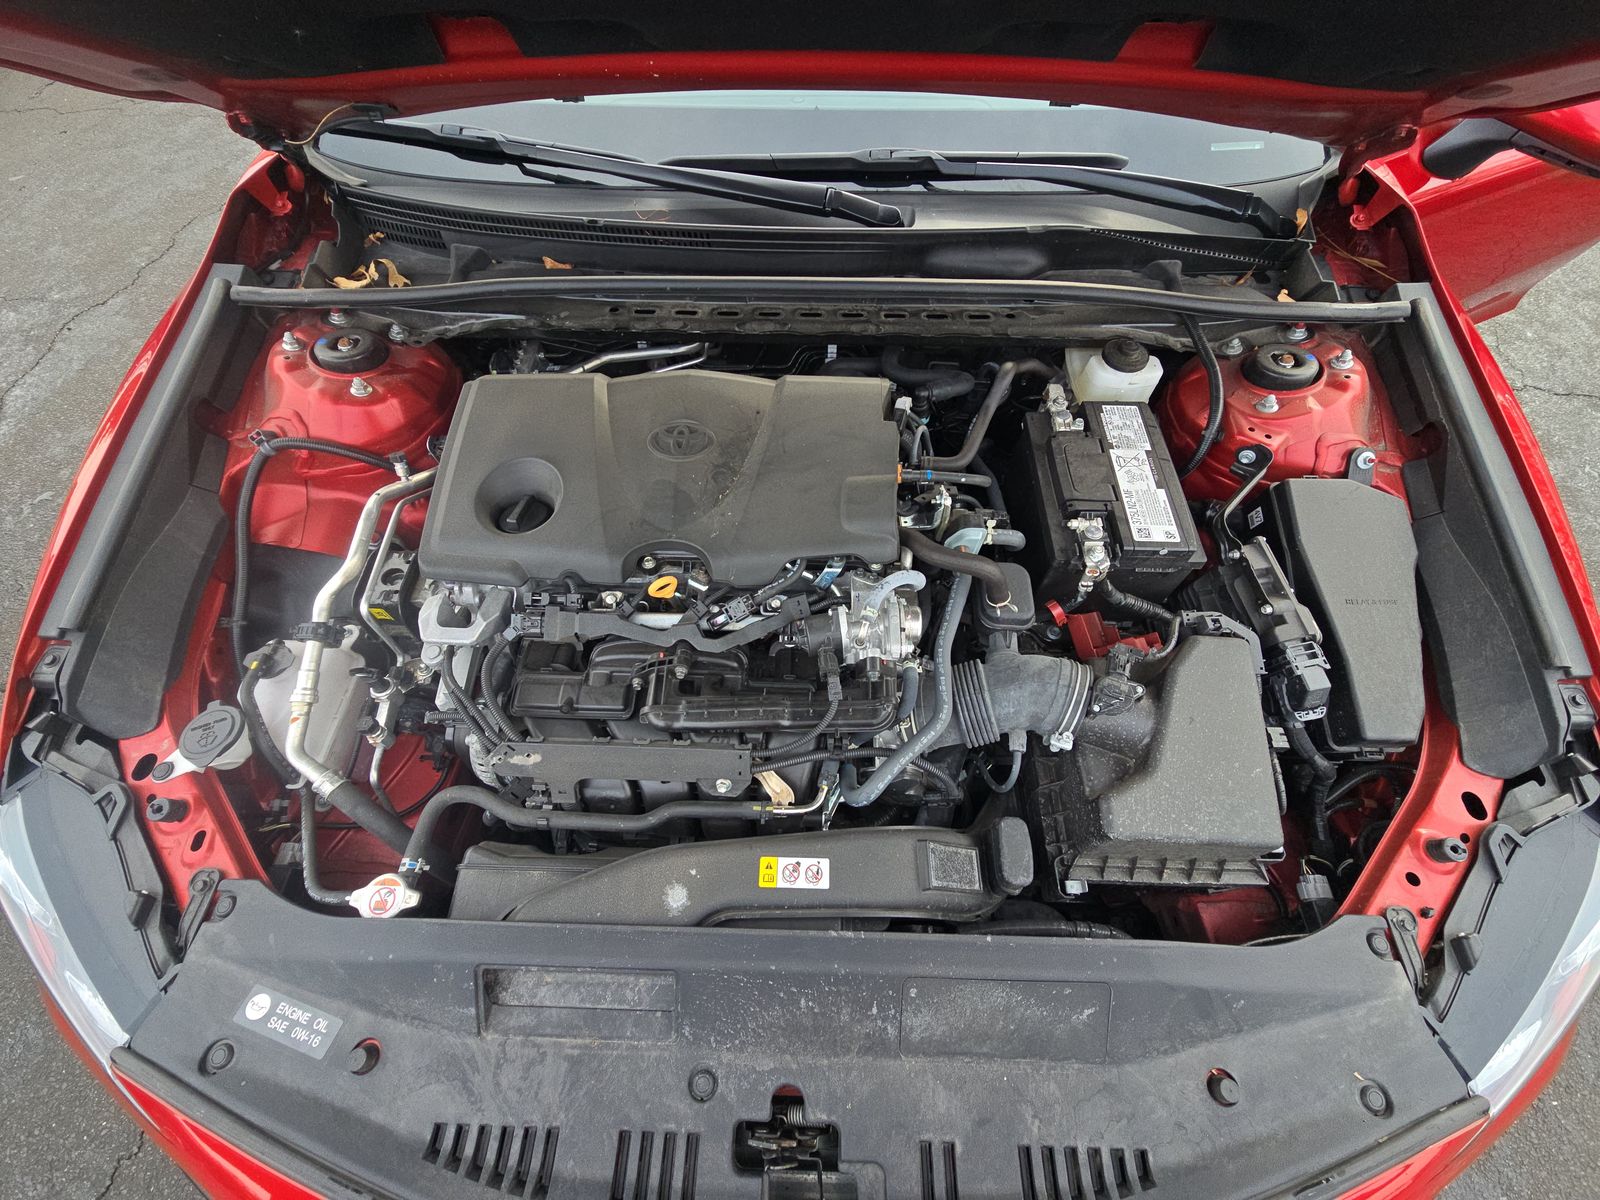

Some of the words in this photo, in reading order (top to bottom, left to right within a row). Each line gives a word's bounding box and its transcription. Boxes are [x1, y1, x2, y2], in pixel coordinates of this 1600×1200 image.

[1123, 488, 1142, 525] 375LN2-MF
[1165, 530, 1176, 540] SP
[267, 1016, 289, 1034] SAE
[291, 1027, 322, 1048] 0W-16
[276, 1002, 312, 1025] ENGINE
[313, 1017, 329, 1033] OIL
